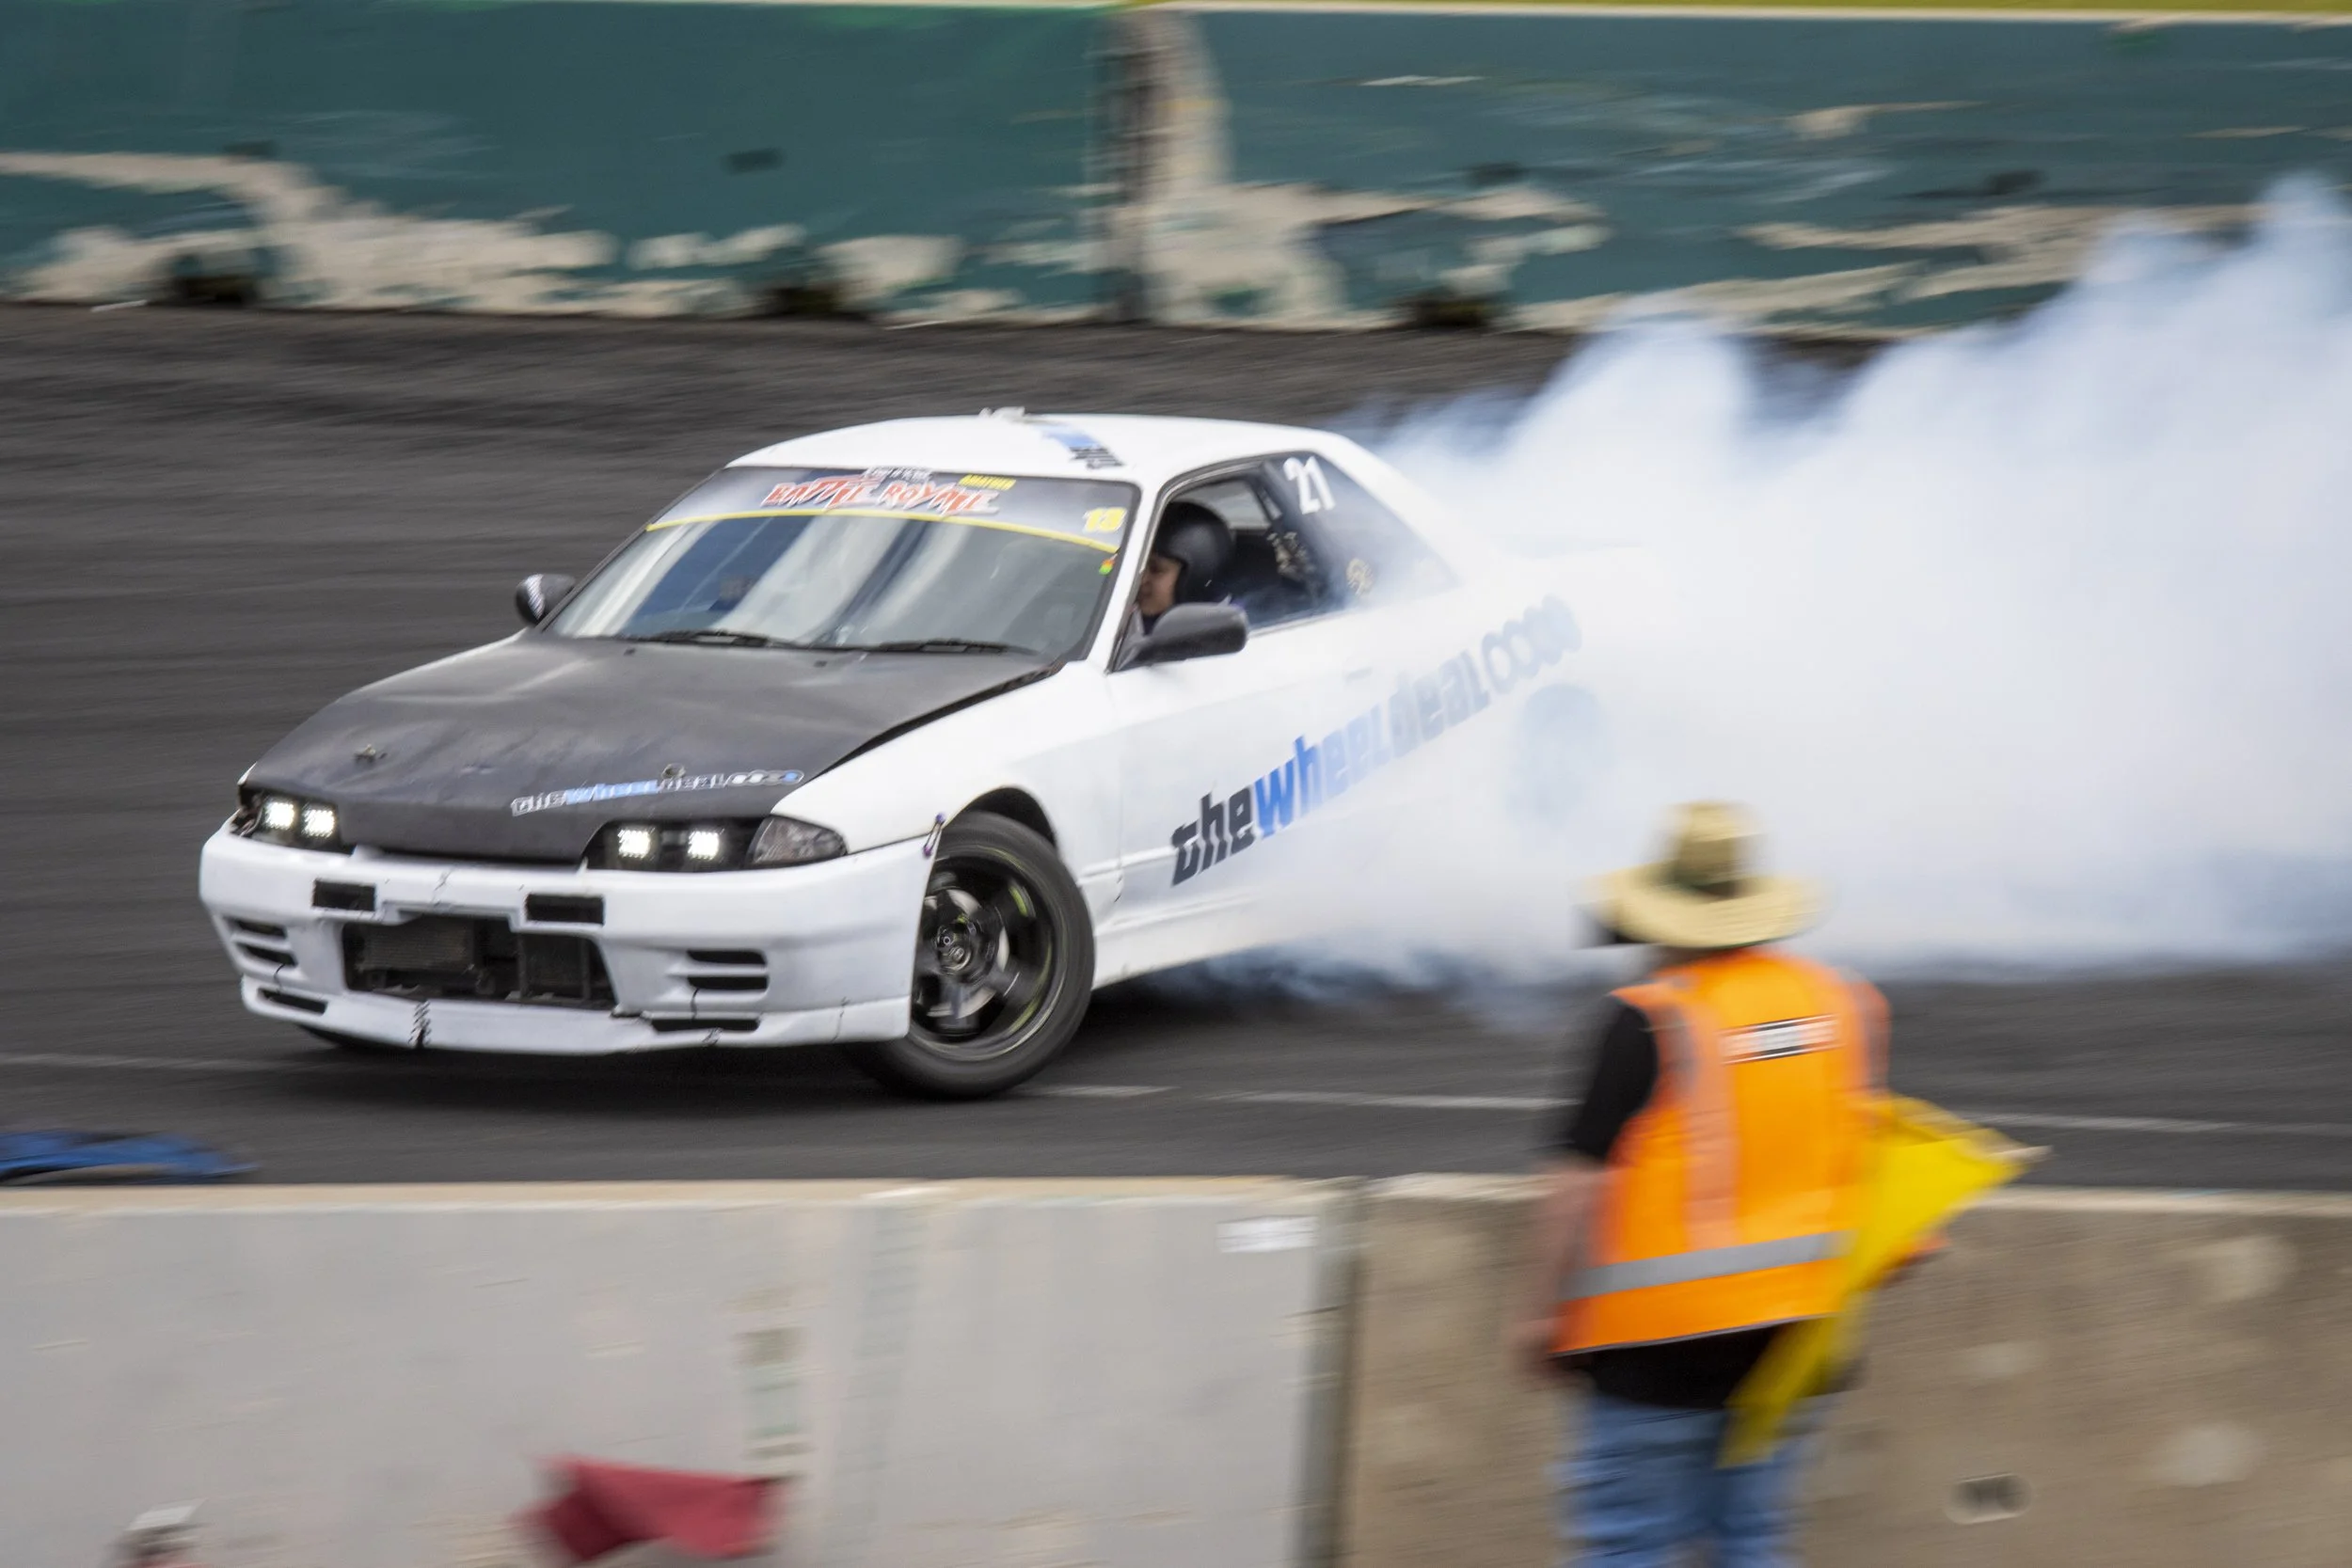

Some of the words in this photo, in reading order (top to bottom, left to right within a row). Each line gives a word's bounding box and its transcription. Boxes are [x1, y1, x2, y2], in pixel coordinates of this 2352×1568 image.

[760, 474, 885, 513] BATTLE
[875, 481, 999, 518] ROYALE
[1283, 456, 1336, 515] 21
